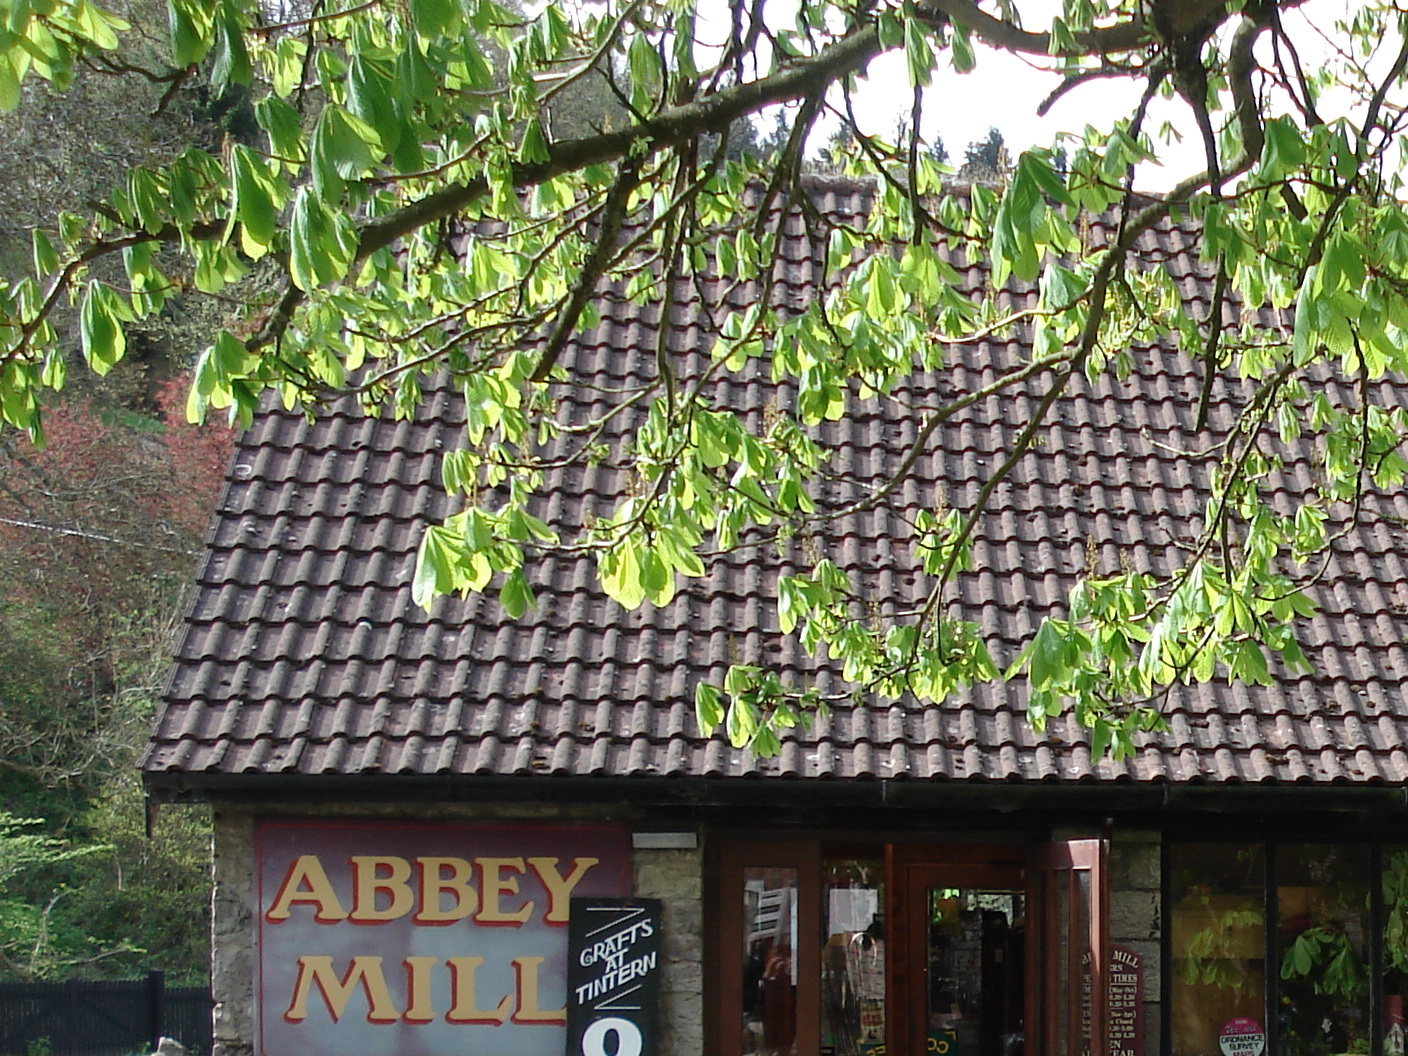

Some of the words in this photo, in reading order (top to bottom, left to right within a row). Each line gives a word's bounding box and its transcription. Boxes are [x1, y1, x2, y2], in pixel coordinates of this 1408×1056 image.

[266, 854, 599, 927] ABBEY
[283, 955, 567, 1026] MILL
[575, 951, 657, 1005] TINTERN
[605, 947, 629, 974] AT
